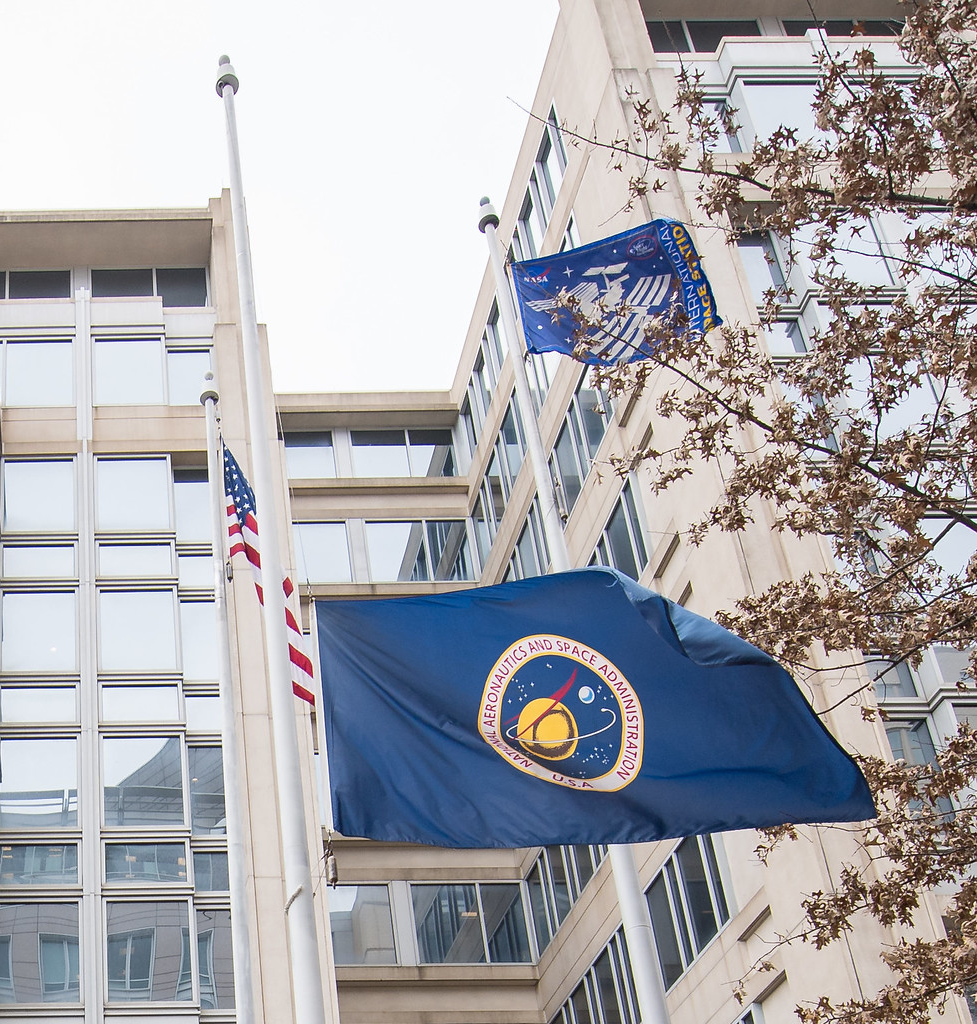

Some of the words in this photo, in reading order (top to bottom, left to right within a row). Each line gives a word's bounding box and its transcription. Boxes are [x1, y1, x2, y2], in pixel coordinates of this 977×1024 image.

[660, 222, 703, 342] TERNATIONAL
[483, 645, 528, 728] AERONAUTICS
[528, 639, 553, 653] AND
[556, 640, 598, 666] SPACE
[598, 664, 639, 781] ADMINISTRATION
